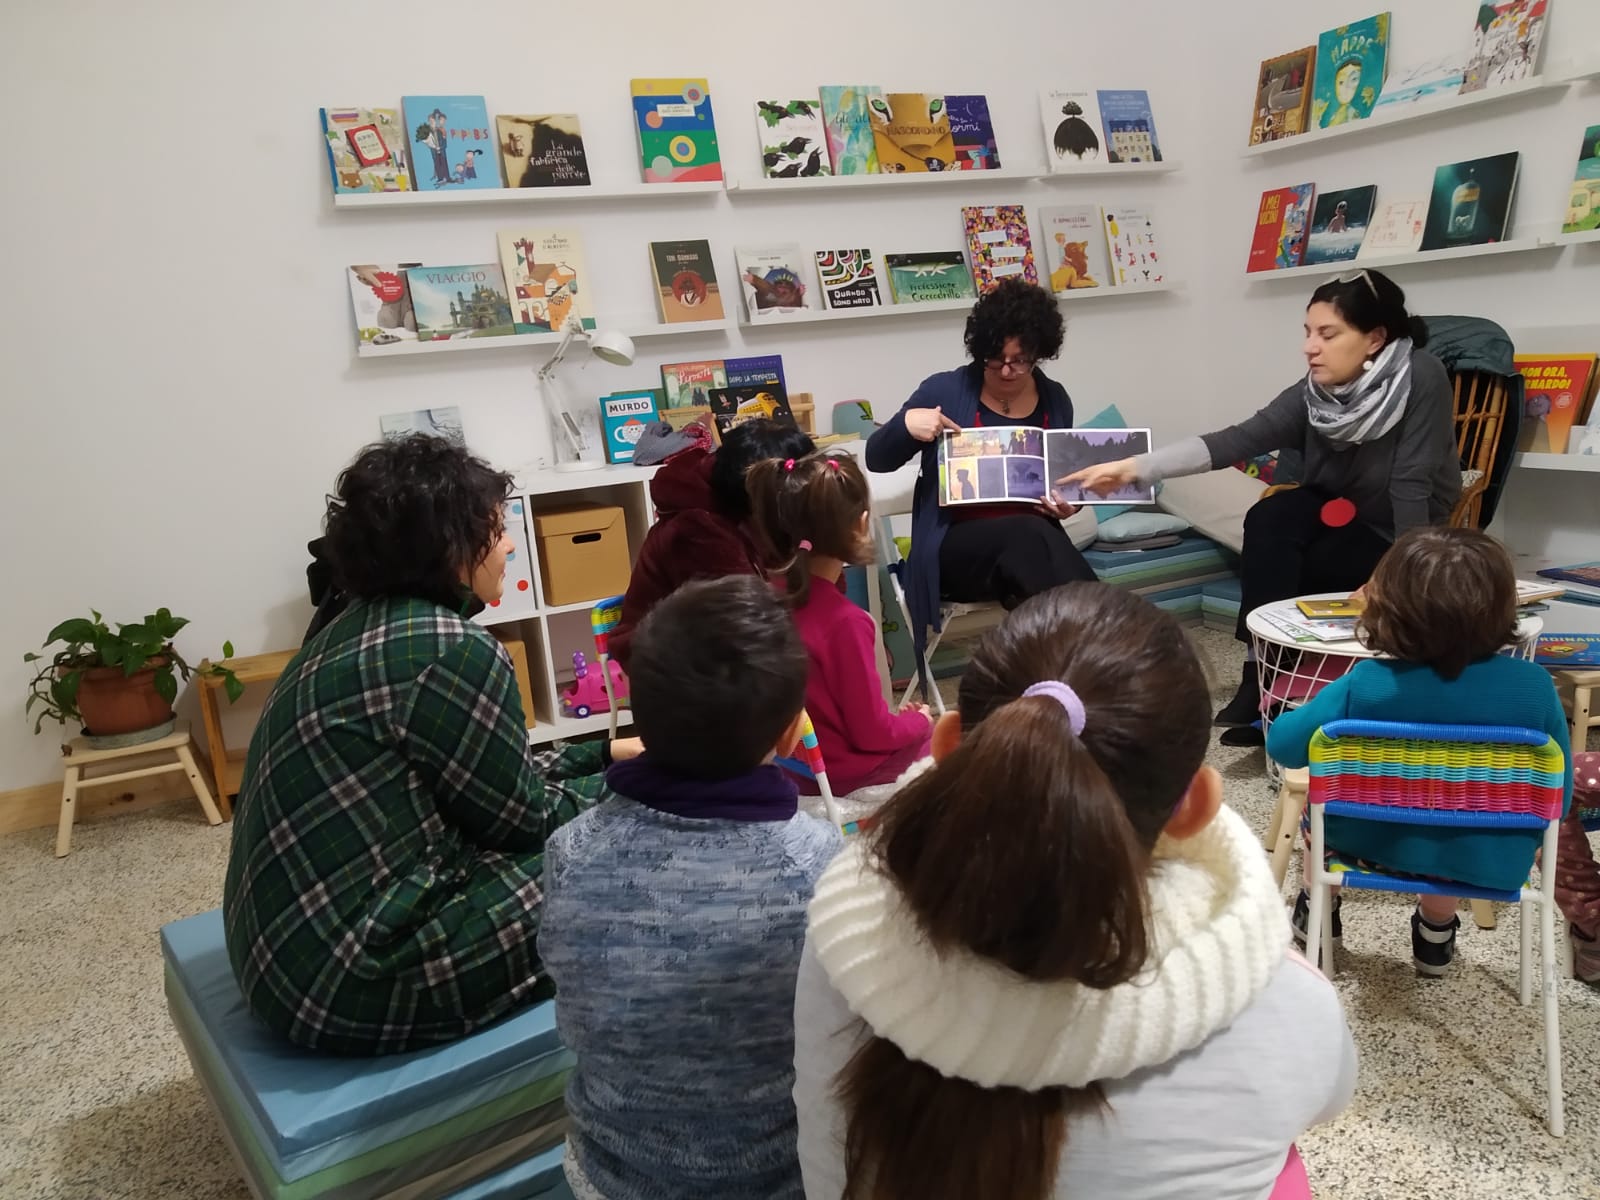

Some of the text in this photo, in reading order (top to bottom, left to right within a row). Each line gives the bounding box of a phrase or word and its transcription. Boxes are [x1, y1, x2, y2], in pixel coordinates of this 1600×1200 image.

[426, 271, 486, 284] VIAGGIO
[834, 290, 866, 300] QUANDO
[833, 297, 871, 307] SONO NATO
[1520, 366, 1543, 378] NON
[609, 401, 649, 413] MURDO
